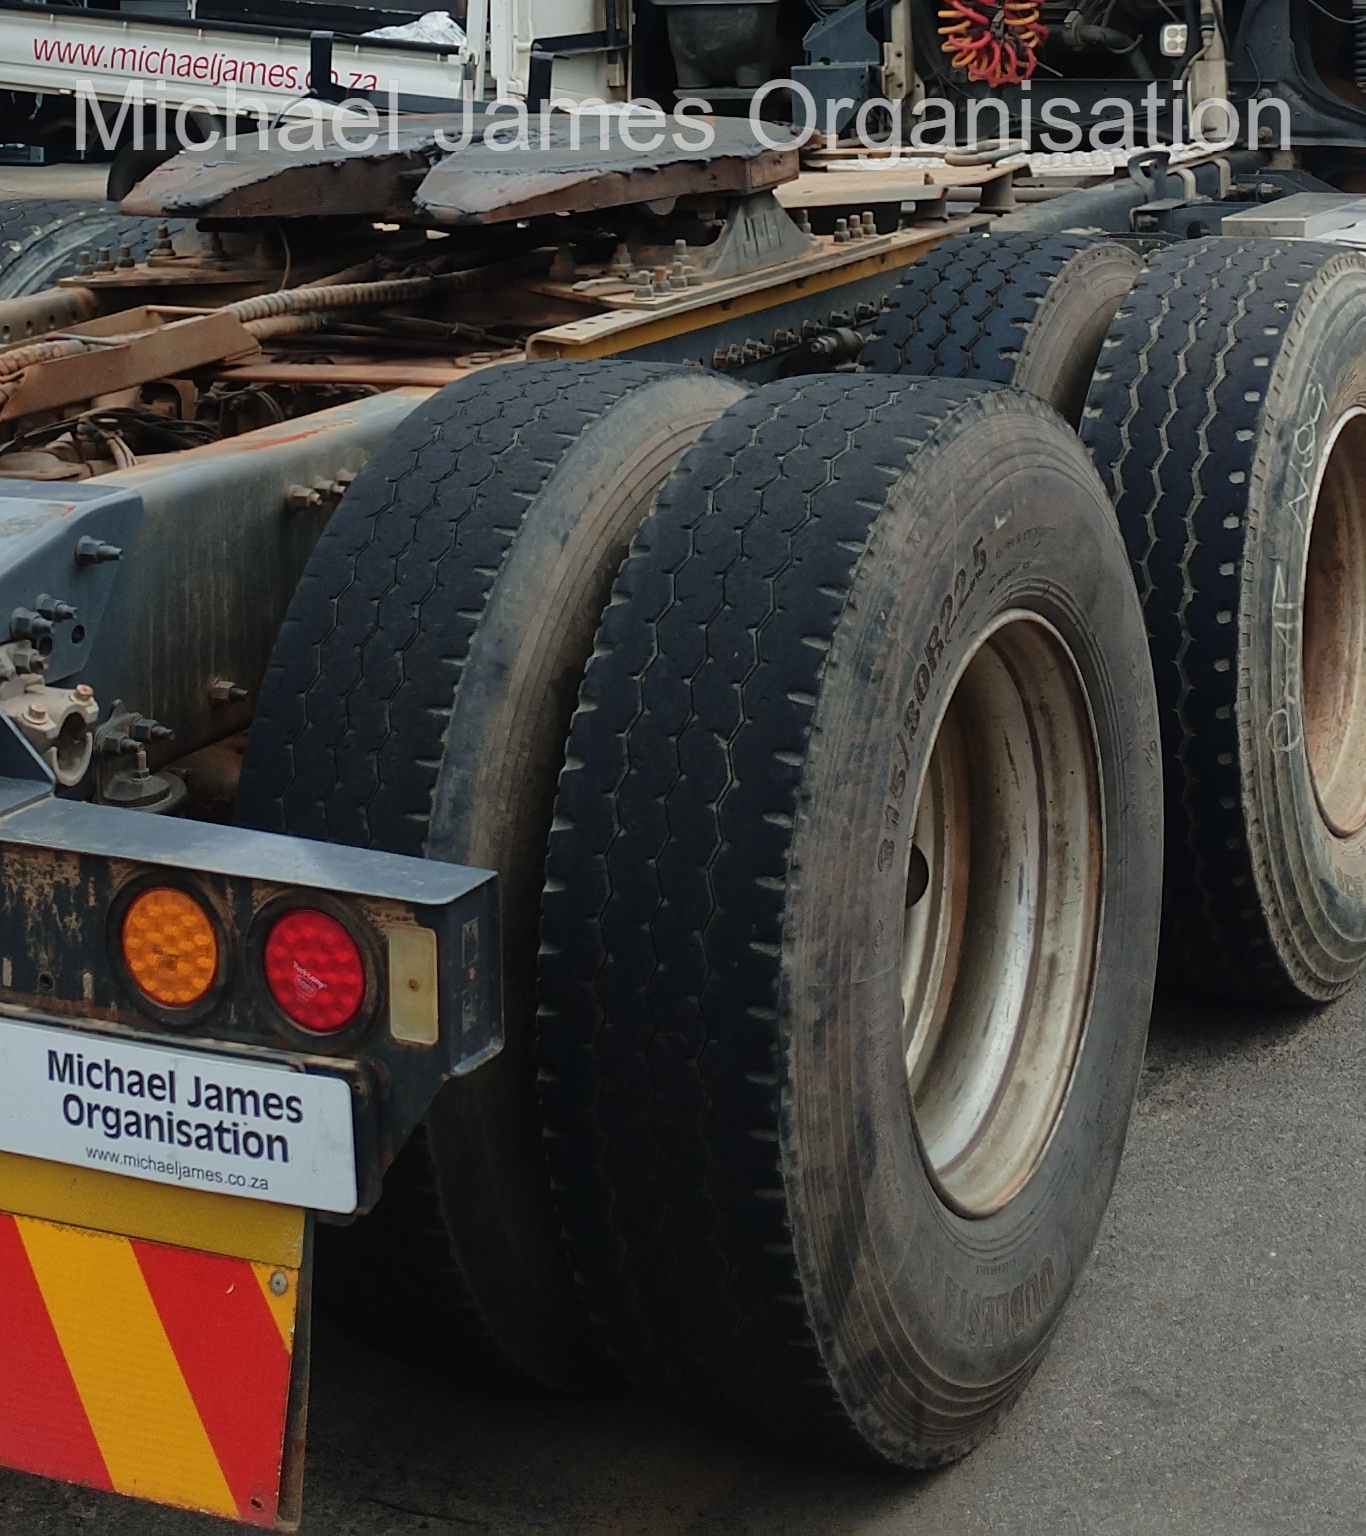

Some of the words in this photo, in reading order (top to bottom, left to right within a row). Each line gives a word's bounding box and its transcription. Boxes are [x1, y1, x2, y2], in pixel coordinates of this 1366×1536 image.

[33, 38, 378, 92] www.michaeljames.za
[47, 1049, 176, 1104] Michael
[187, 1075, 304, 1124] James
[62, 1093, 290, 1163] Organisation
[85, 1146, 270, 1191] www.michaeljames.co.za
